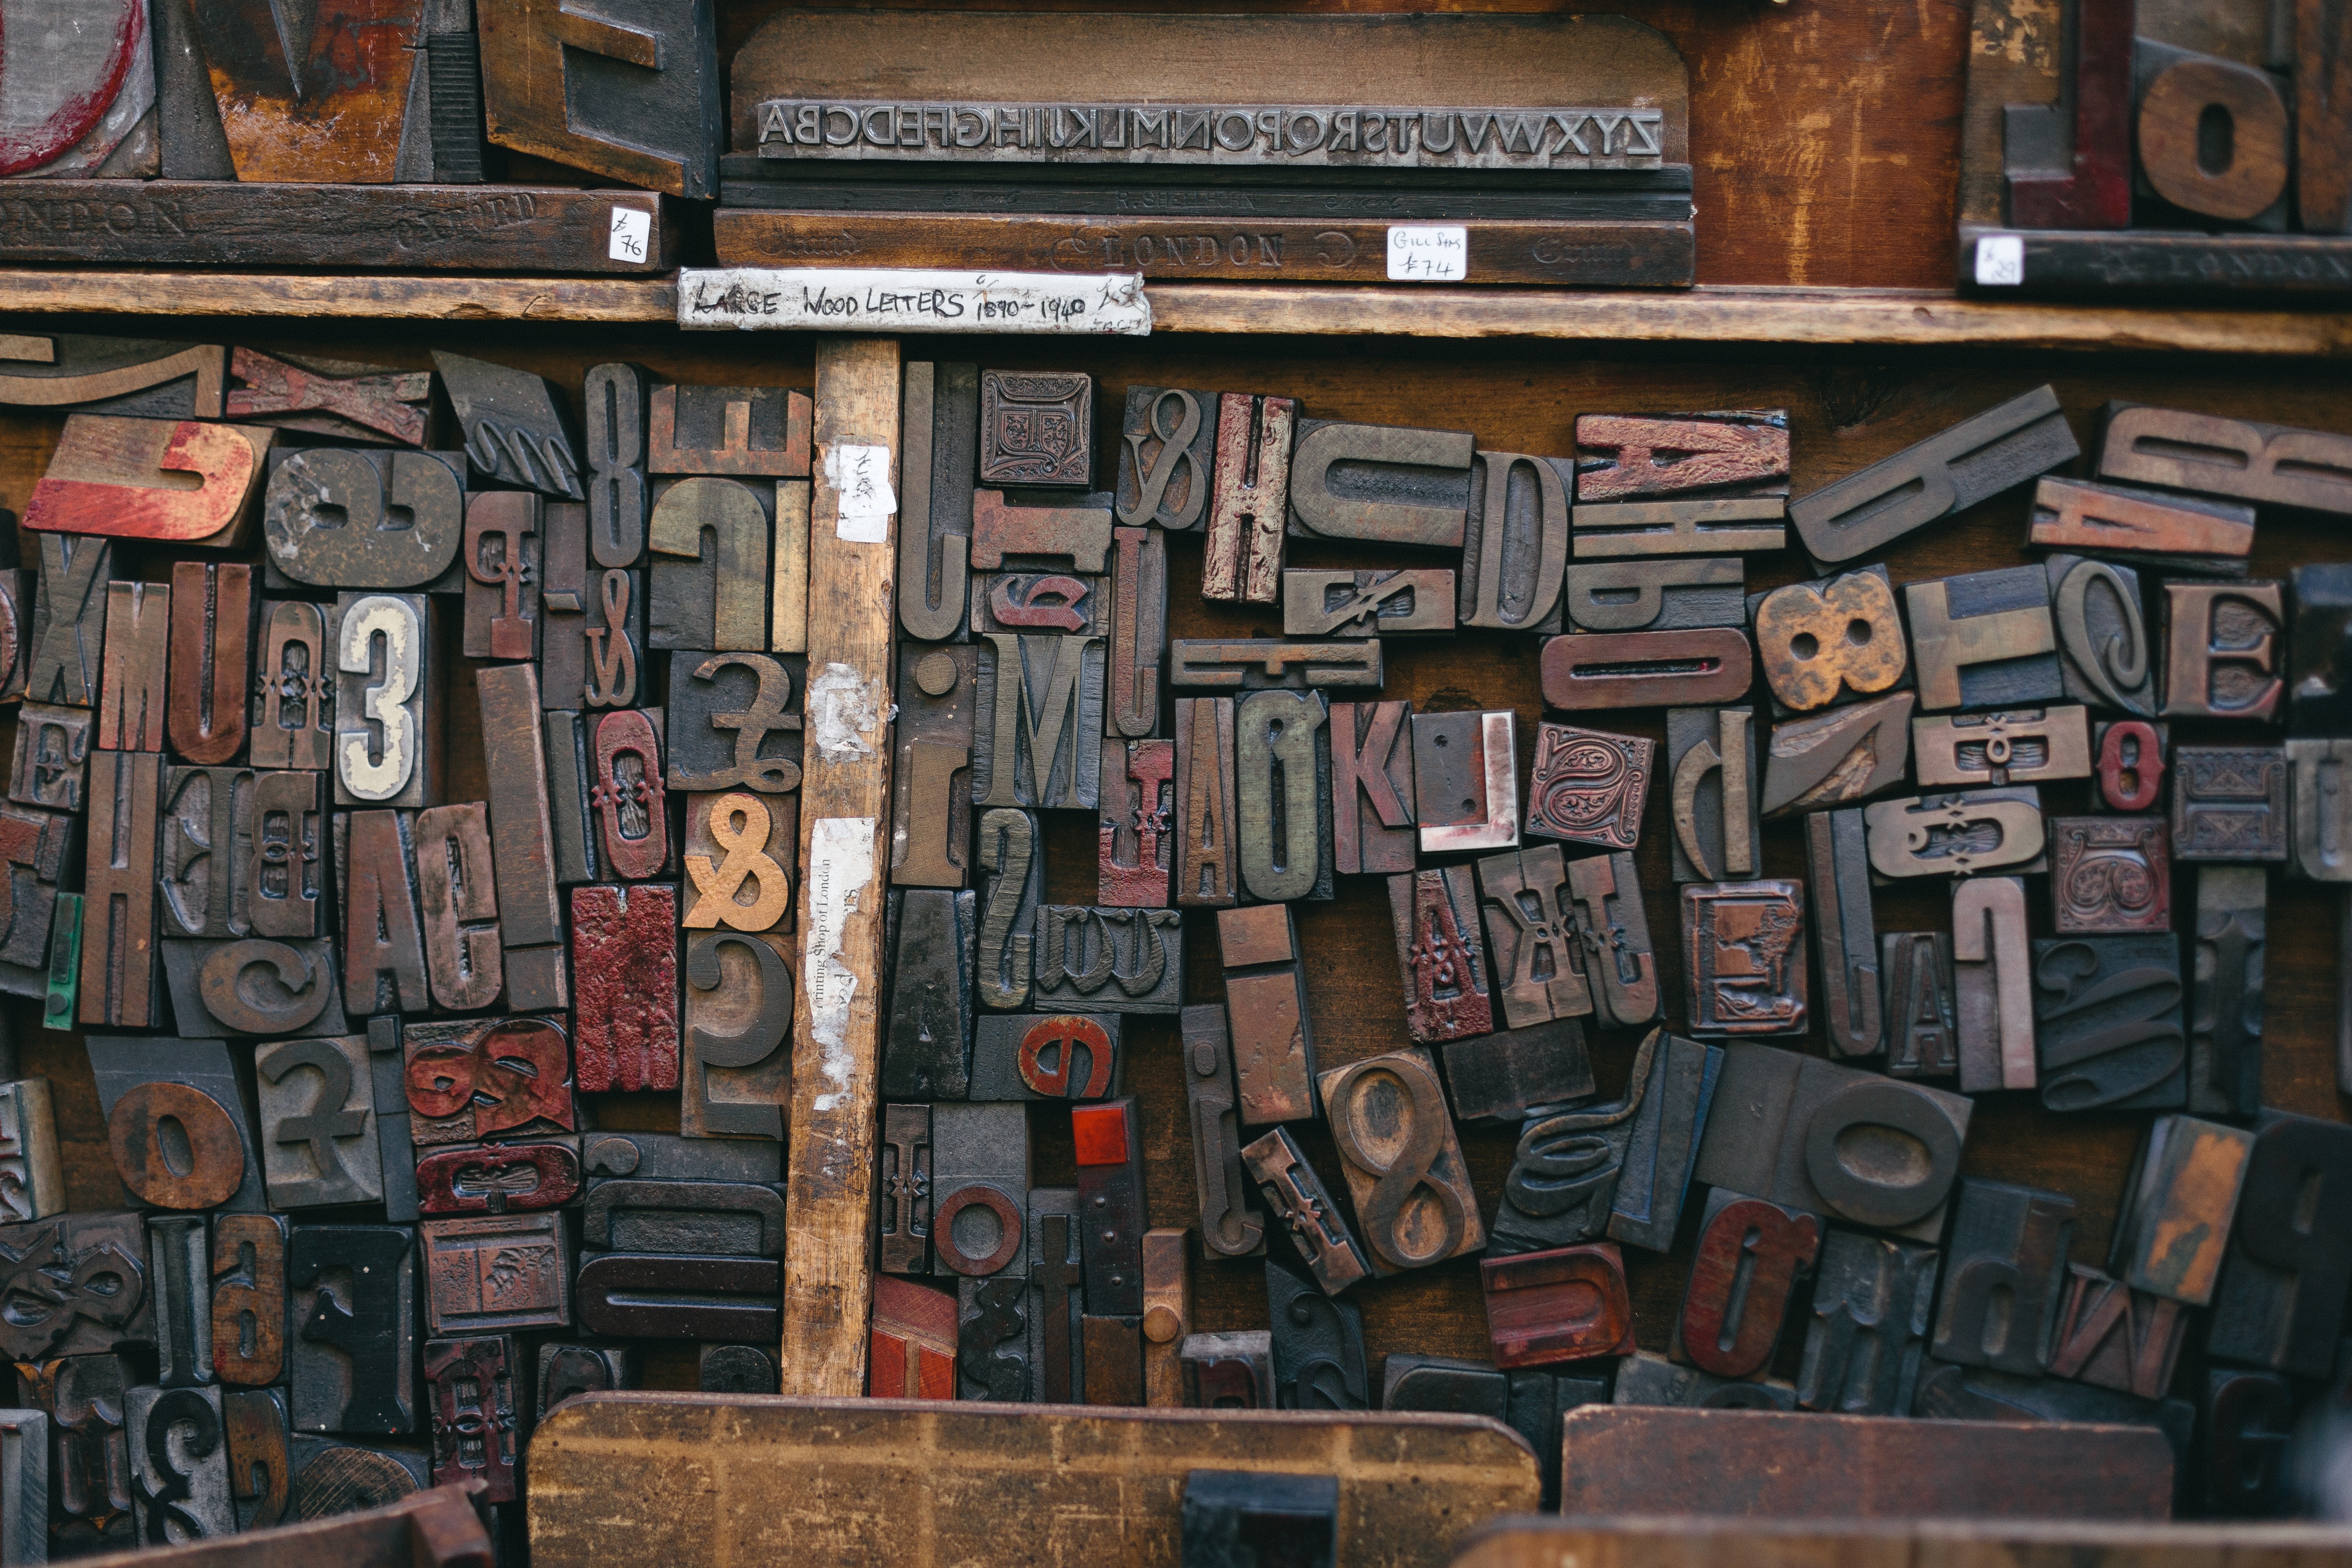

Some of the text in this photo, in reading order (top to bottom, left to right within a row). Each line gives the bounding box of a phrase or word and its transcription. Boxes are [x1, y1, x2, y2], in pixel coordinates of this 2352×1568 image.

[621, 235, 642, 256] 76
[1102, 233, 1284, 267] LONDON
[802, 284, 859, 317] WOOD
[865, 287, 965, 318] LETTERS
[339, 595, 421, 801] 3
[971, 633, 1105, 809] M
[80, 752, 167, 1027] H
[814, 924, 830, 957] Shop
